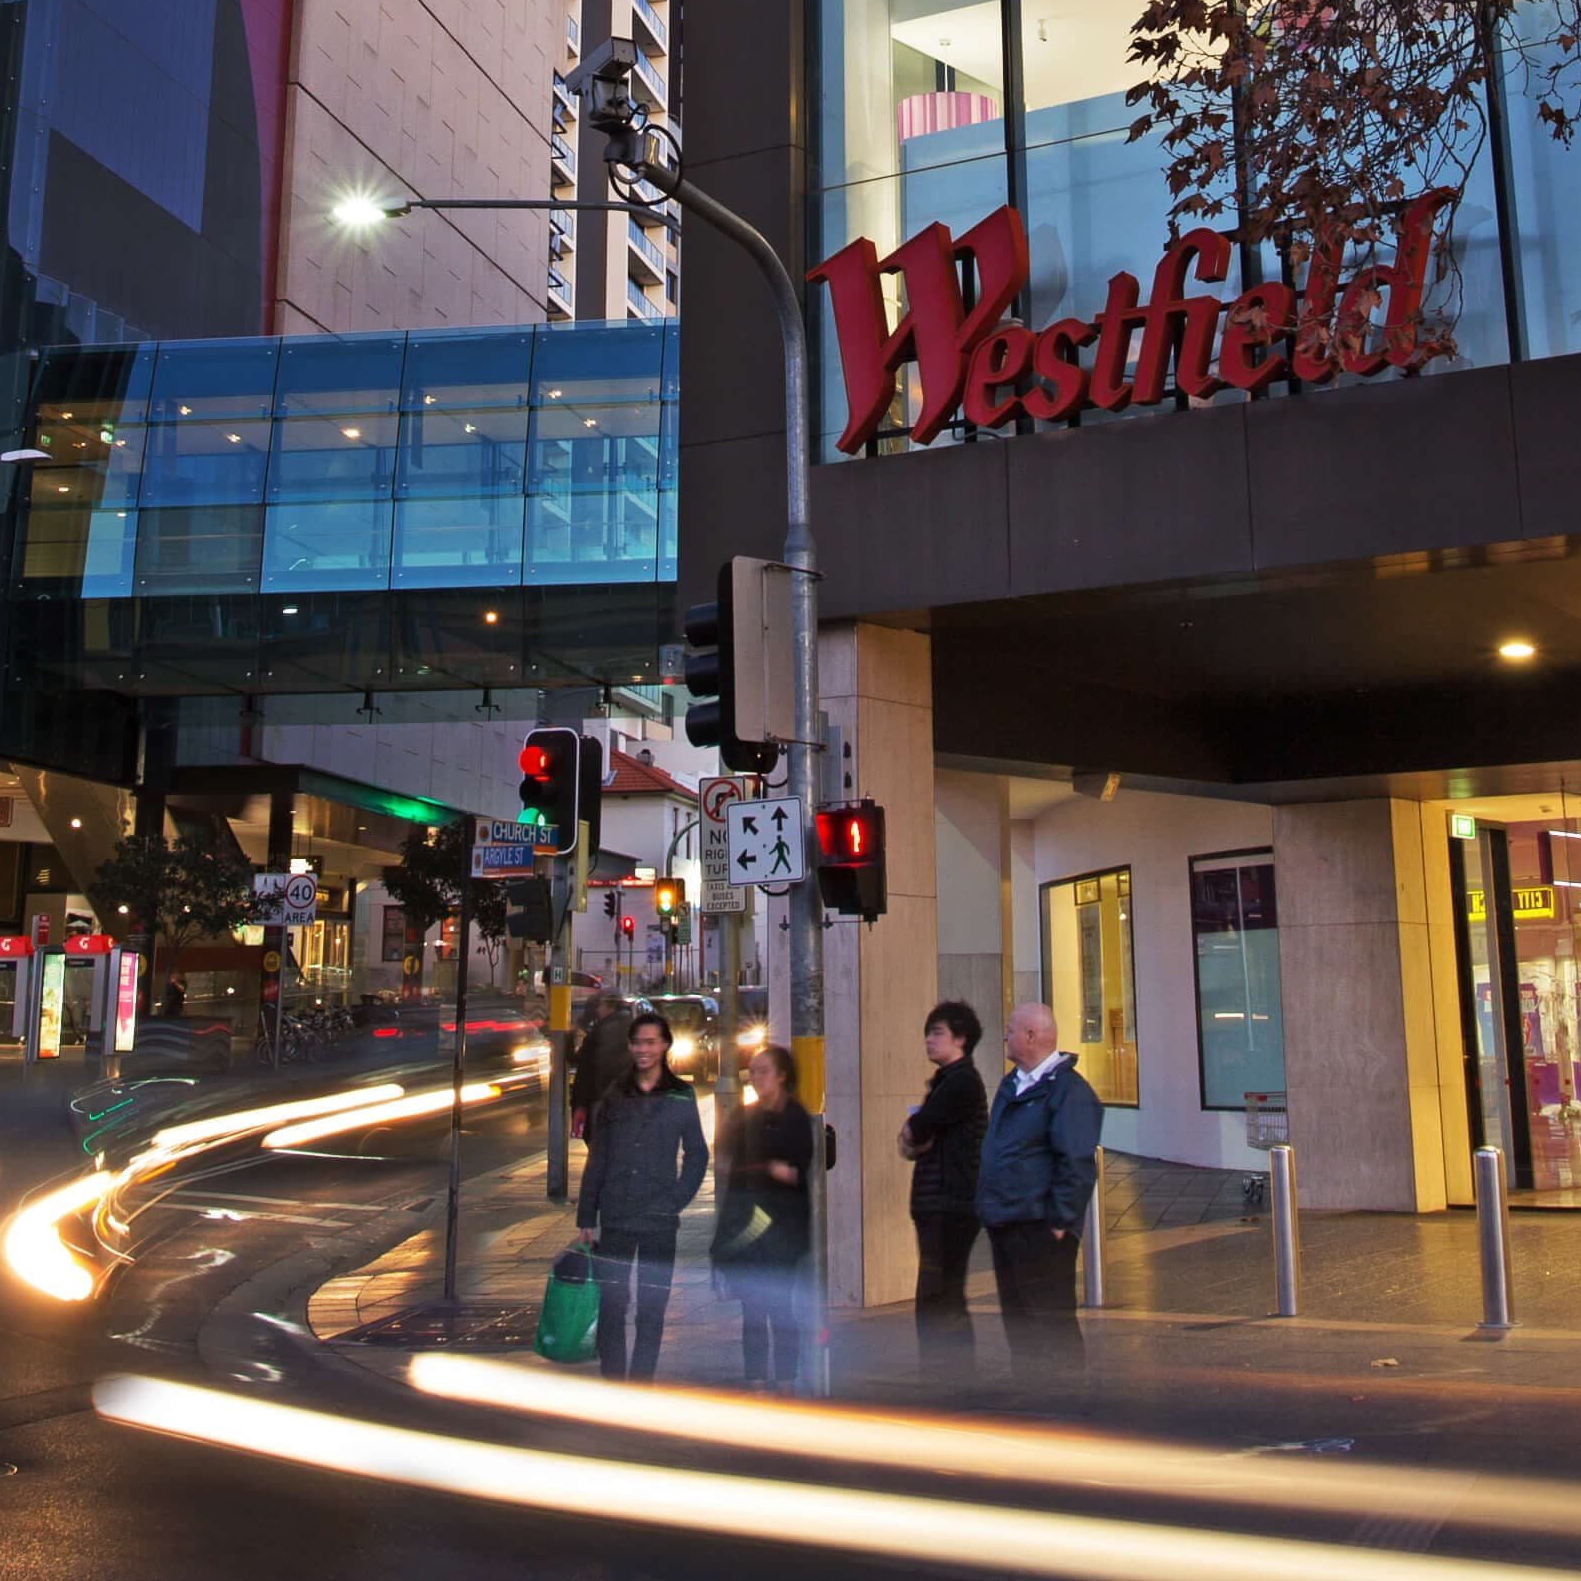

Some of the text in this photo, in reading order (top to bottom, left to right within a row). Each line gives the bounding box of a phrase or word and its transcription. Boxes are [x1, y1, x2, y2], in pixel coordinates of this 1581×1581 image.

[806, 186, 1458, 456] Westfield
[493, 821, 553, 844] CHURCH ST
[484, 847, 524, 866] ARGYLE ST
[705, 849, 728, 860] RIG
[706, 864, 728, 875] TUR
[706, 882, 725, 891] TAXIS
[289, 884, 313, 901] 40
[712, 892, 734, 900] BUSES
[706, 901, 740, 910] EXCEPTED
[284, 911, 314, 923] AREA
